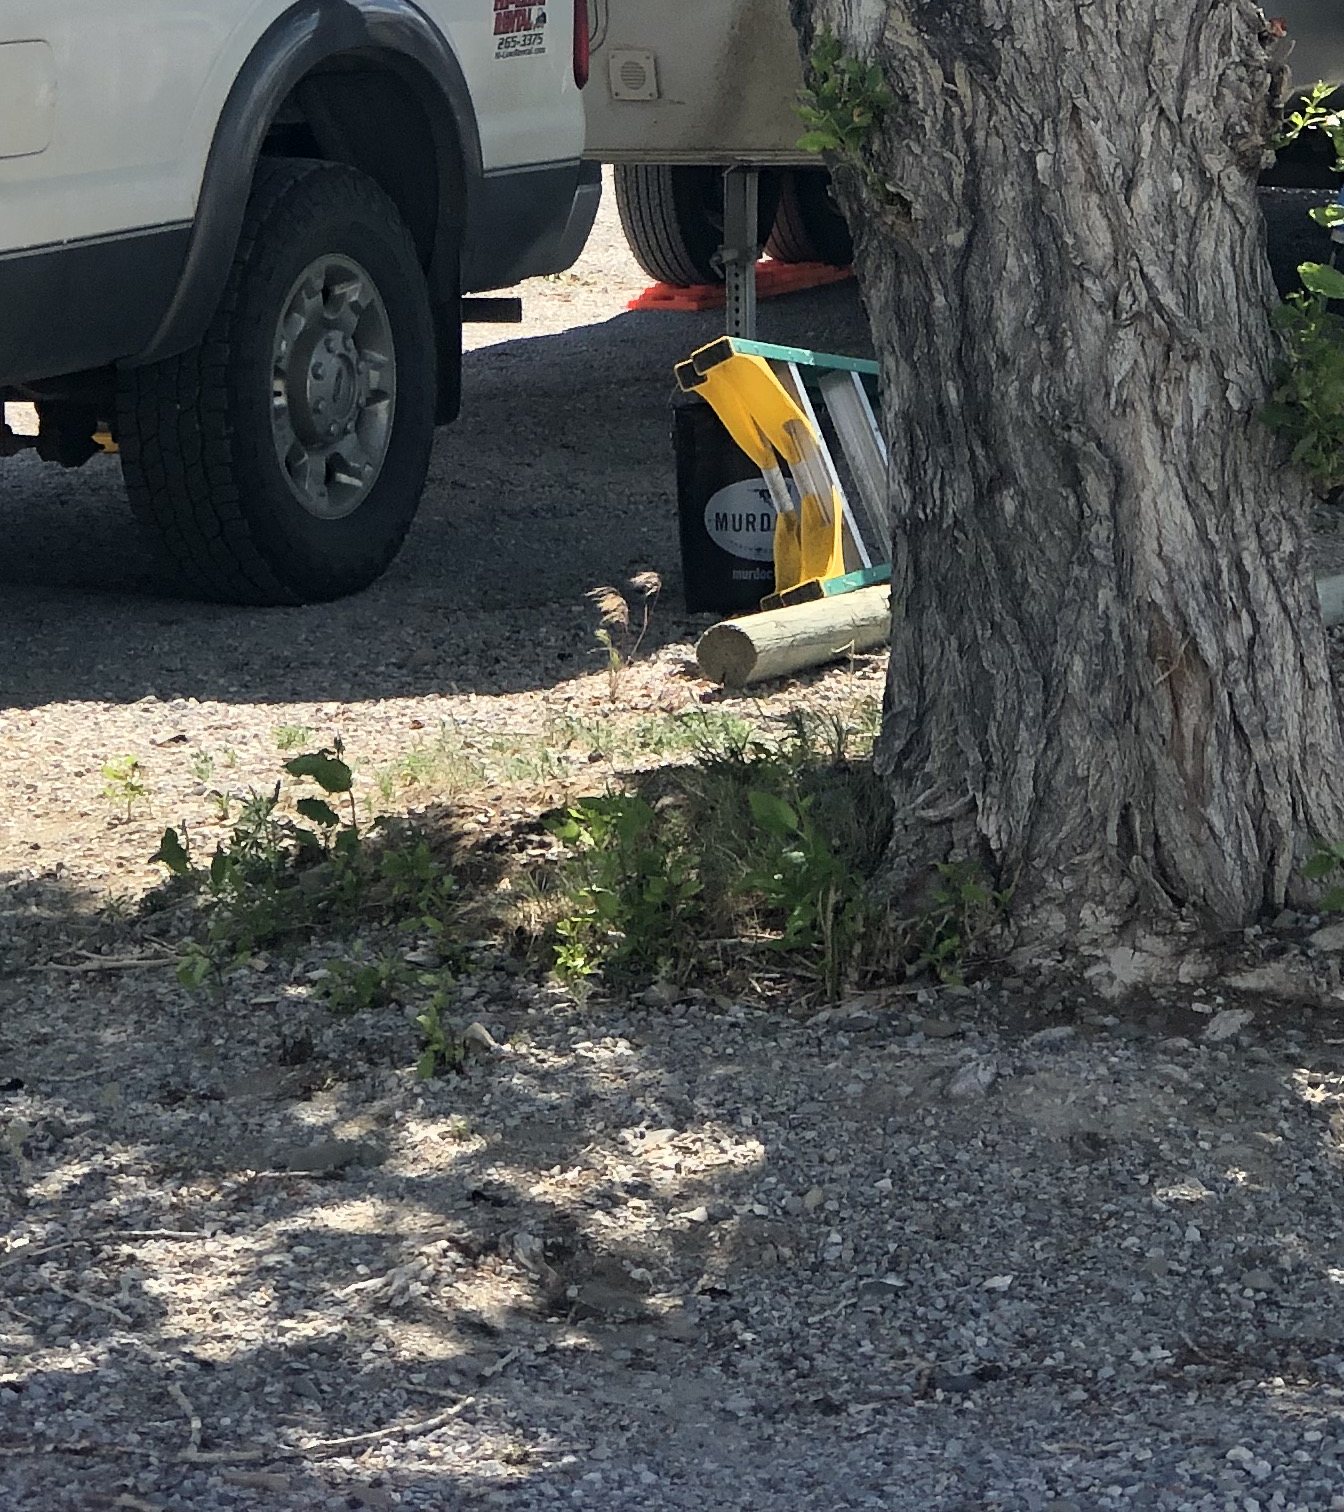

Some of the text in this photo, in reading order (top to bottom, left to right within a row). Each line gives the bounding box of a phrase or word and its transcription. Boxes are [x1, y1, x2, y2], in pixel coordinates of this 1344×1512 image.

[497, 33, 544, 50] 265-3375
[714, 512, 776, 533] MURD
[732, 568, 774, 580] murdoc
